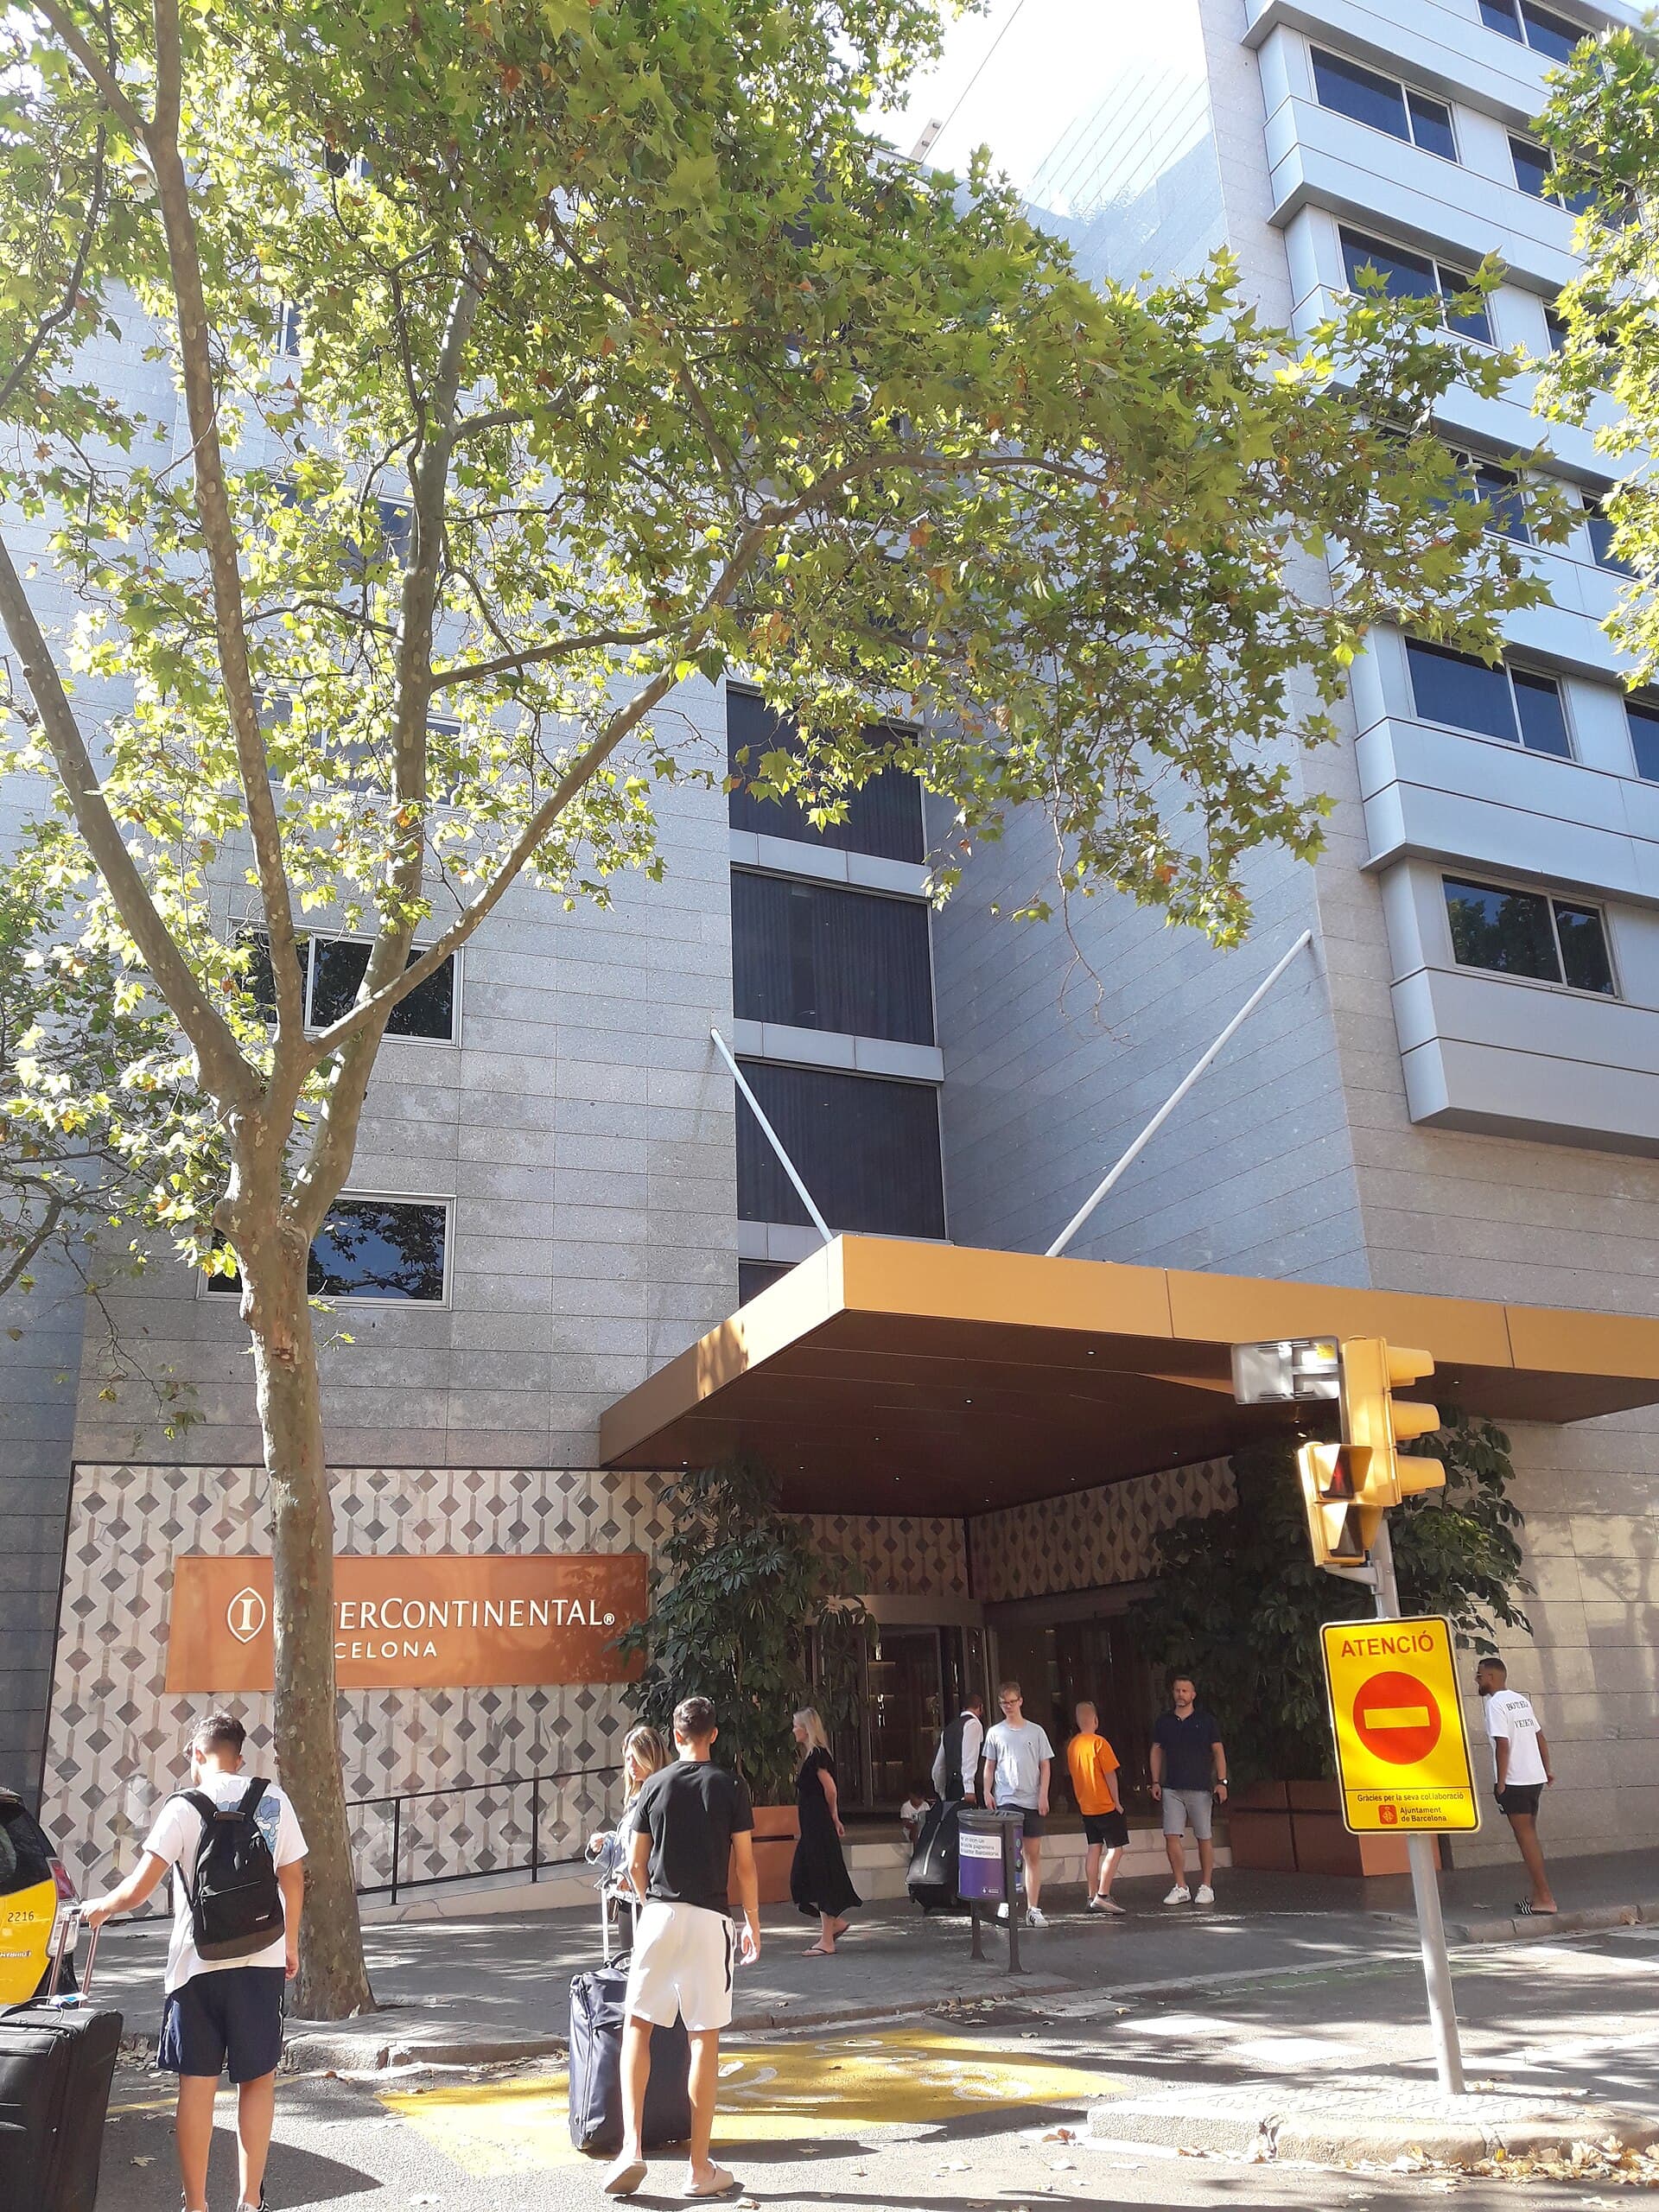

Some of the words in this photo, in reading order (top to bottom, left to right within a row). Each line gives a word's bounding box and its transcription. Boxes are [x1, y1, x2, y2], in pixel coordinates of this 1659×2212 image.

[334, 1641, 437, 1659] CELONA
[1341, 1630, 1434, 1657] ATENCIÓ
[1357, 1794, 1382, 1802] Gràcies
[1400, 1806, 1442, 1815] Ajuntament
[7, 1910, 35, 1923] 2216
